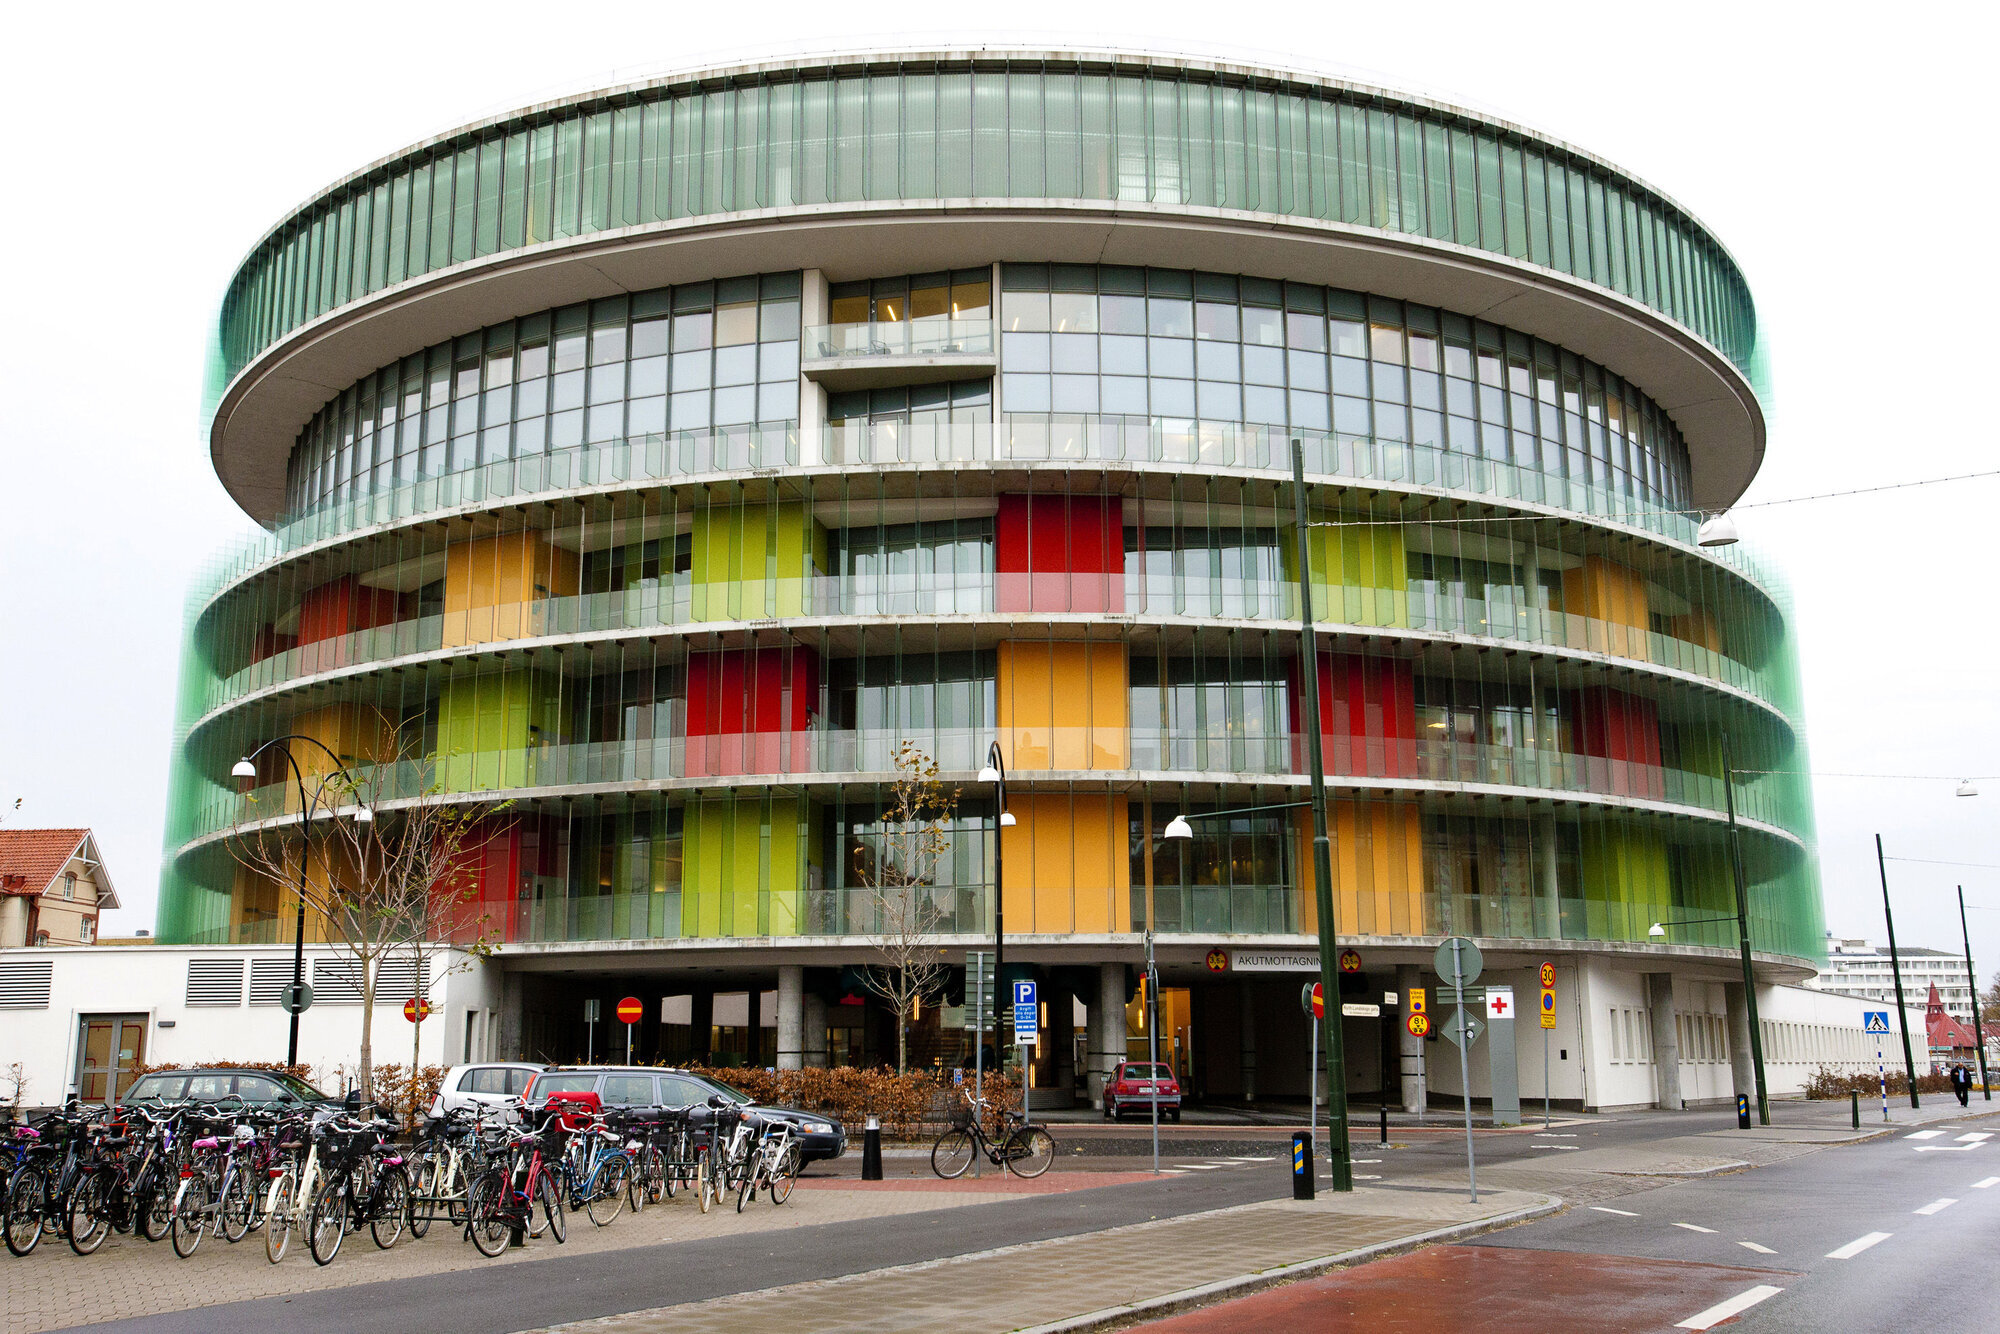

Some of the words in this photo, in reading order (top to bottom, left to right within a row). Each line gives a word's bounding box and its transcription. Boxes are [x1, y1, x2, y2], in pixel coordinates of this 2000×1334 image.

[1238, 956, 1321, 966] AKUTMOTTAGNIN
[1543, 969, 1554, 982] 30
[1020, 984, 1032, 1002] P
